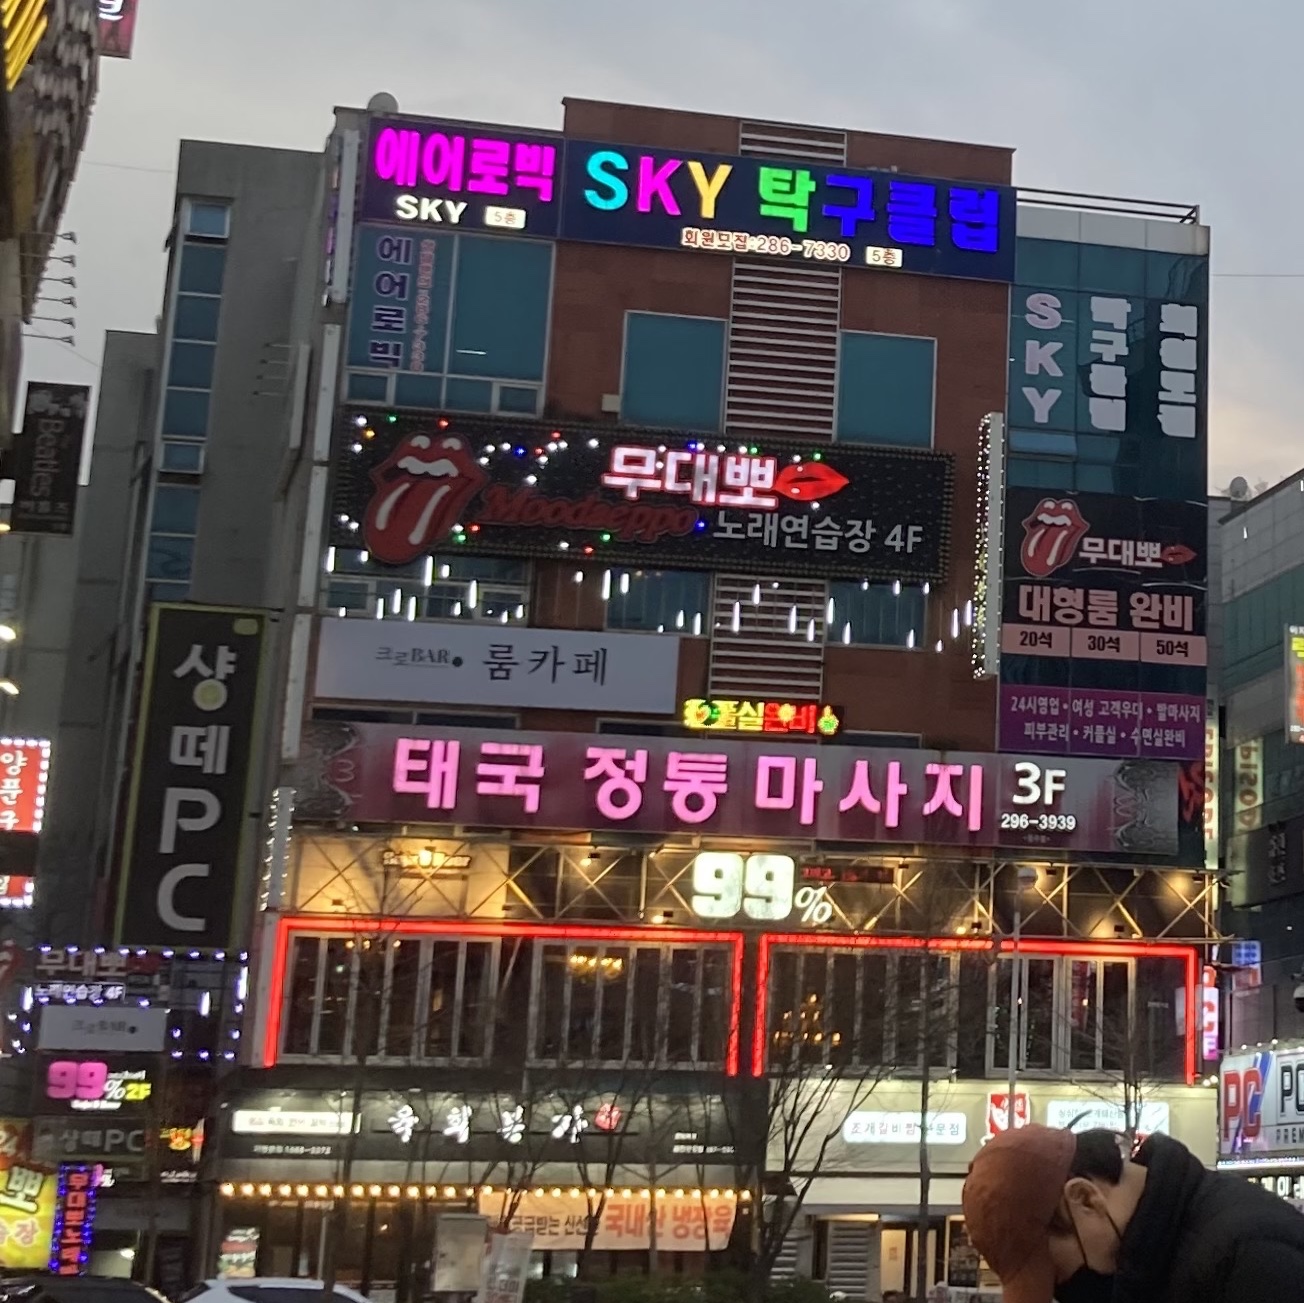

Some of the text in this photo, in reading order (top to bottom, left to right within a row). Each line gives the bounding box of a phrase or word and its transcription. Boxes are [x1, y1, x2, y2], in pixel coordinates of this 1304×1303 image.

[376, 127, 556, 202] 에어로빅
[395, 194, 467, 224] SKY
[583, 151, 999, 252] SKY 탁구클럽
[370, 235, 413, 370] 에어로빅
[1021, 293, 1064, 424] SKY
[603, 446, 779, 509] 무대뽀
[713, 510, 923, 554] 노래연습장 4F
[1079, 537, 1163, 568] 무대뽀
[1019, 584, 1193, 632] 대형룸 완비
[482, 643, 607, 686] 룸카페
[1020, 630, 1189, 658] 20석 30석 50석
[1072, 699, 1094, 718] 여성
[1024, 722, 1069, 742] 피부관리
[393, 738, 983, 832] 태국 정통 마사지
[1012, 761, 1067, 805] 3F
[1000, 813, 1077, 831] 296-3939
[691, 852, 833, 924] 99%
[1224, 1068, 1263, 1141] PC
